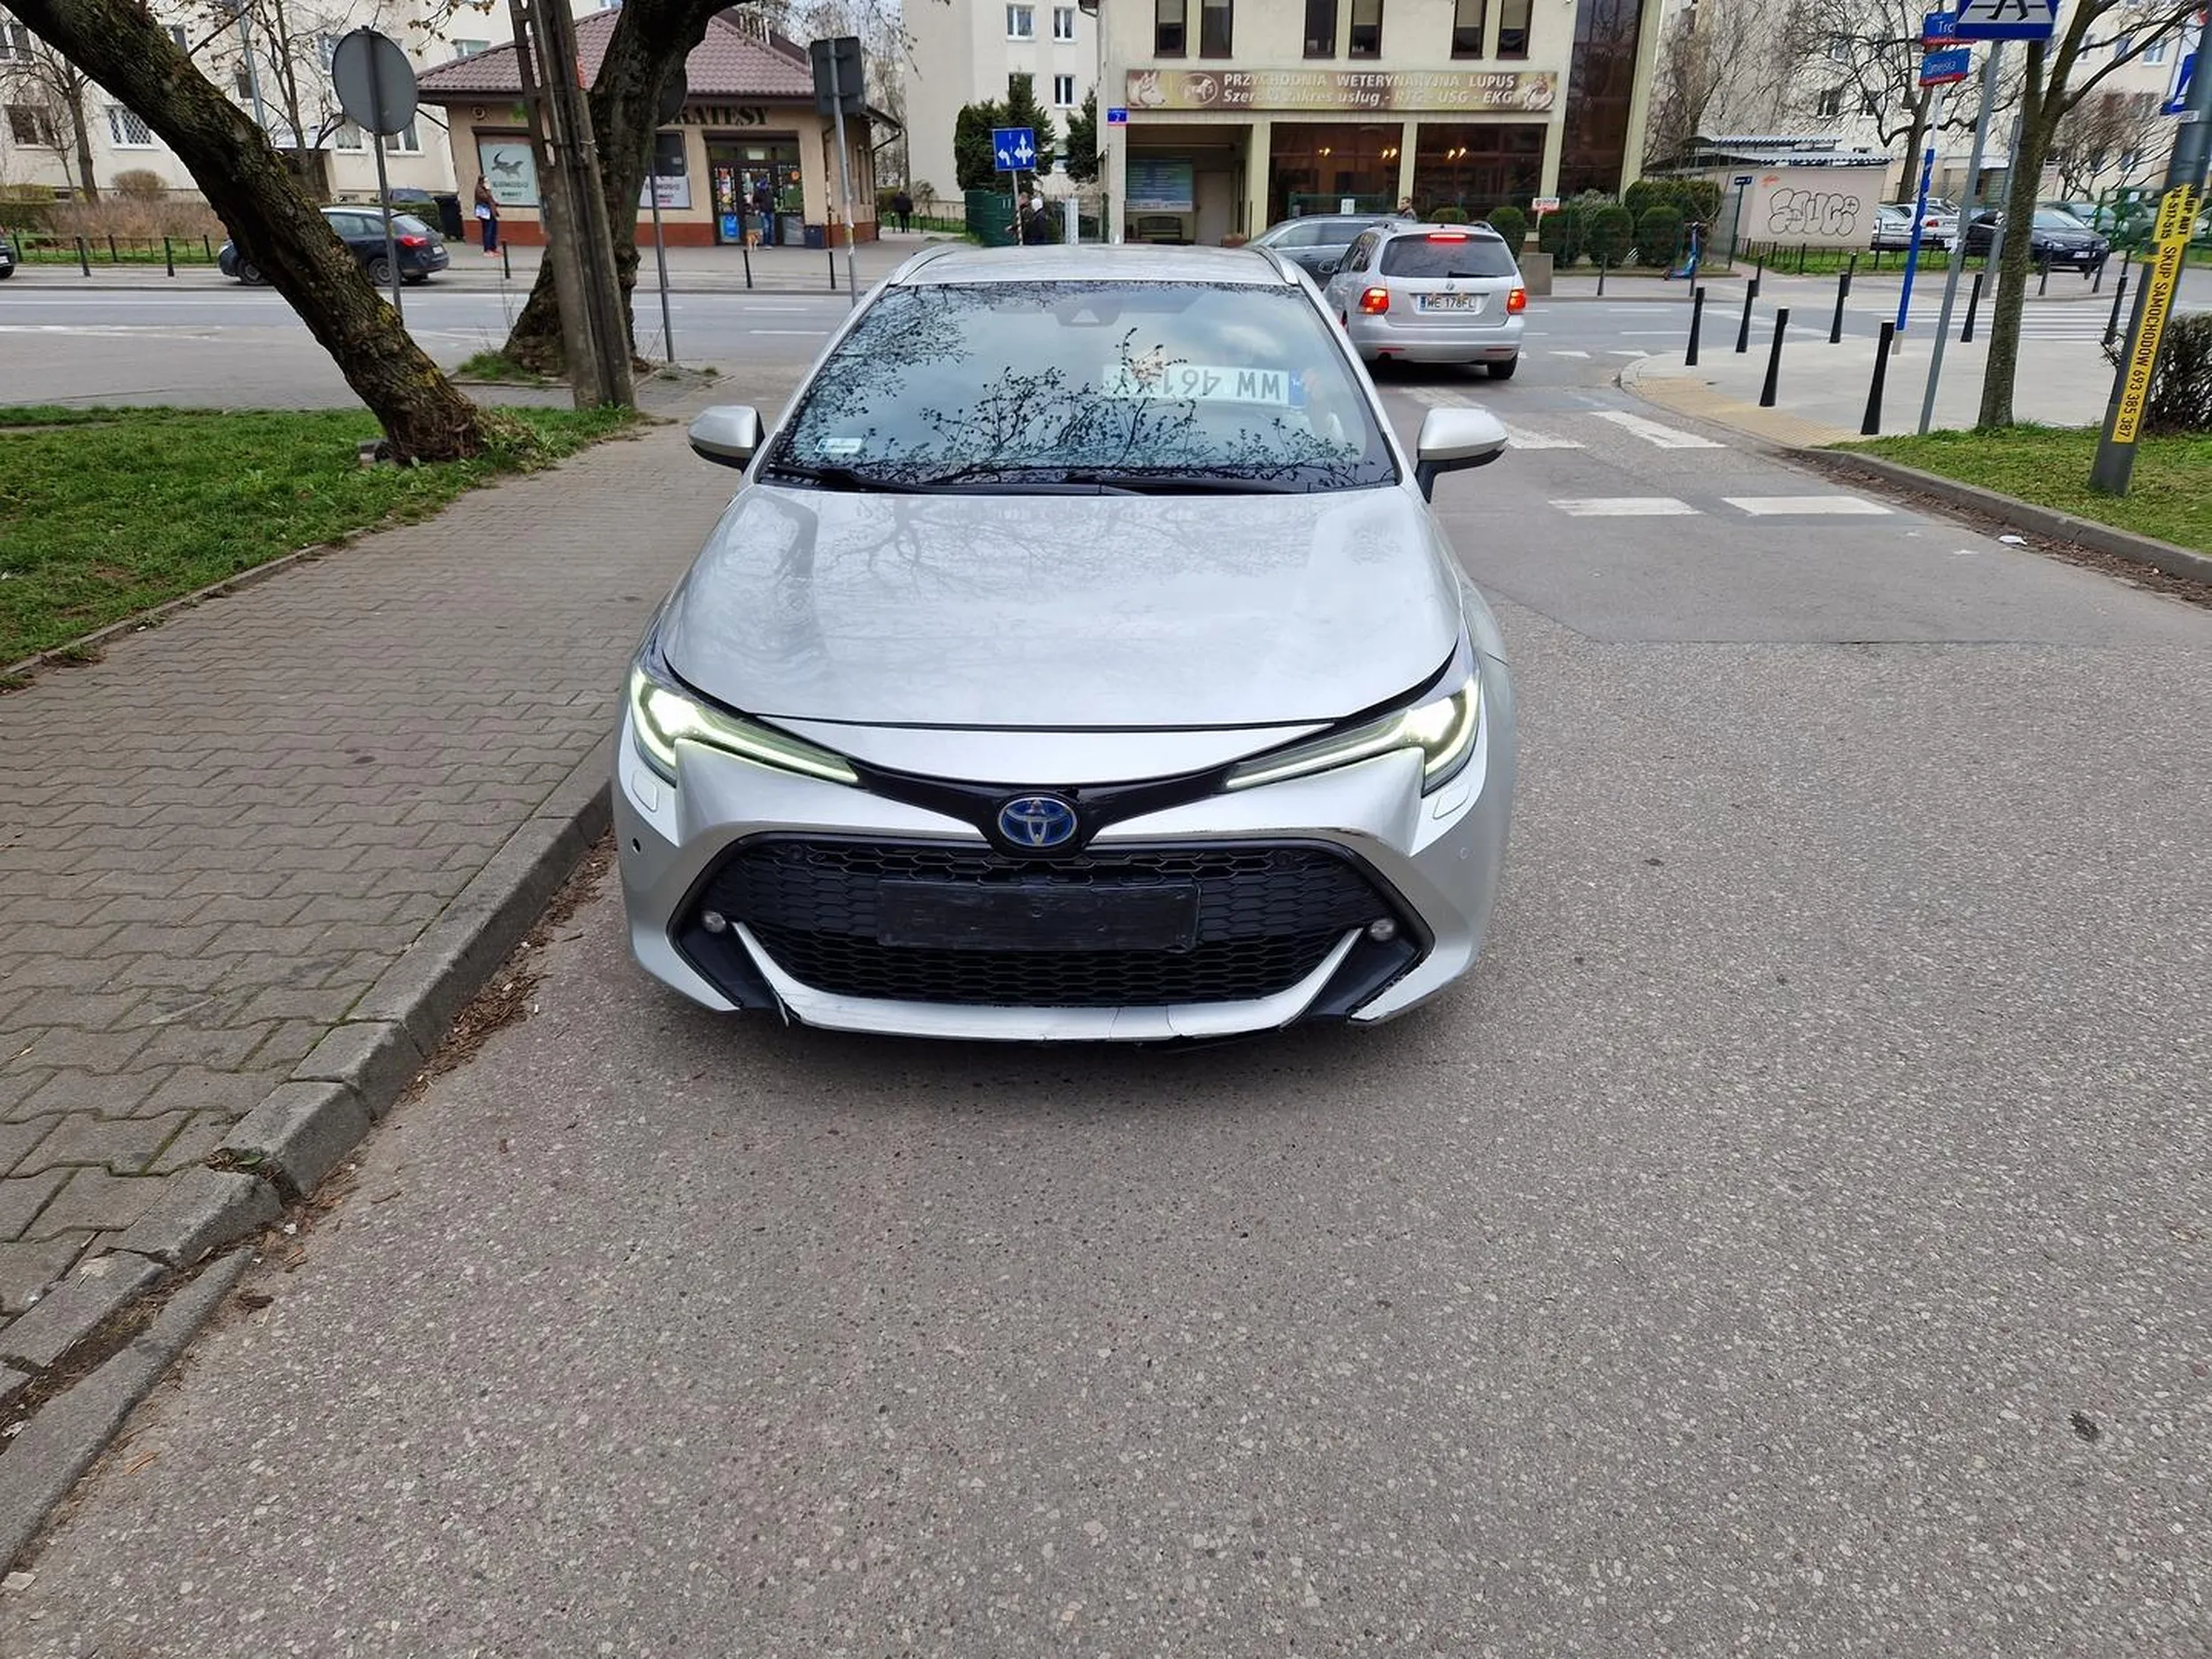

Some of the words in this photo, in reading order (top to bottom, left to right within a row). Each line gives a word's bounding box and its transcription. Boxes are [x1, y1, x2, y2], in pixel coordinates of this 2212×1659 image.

[1469, 74, 1516, 88] LUPUS
[1438, 90, 1470, 104] USG
[1482, 90, 1514, 104] EKG
[2158, 246, 2177, 279] SKUP
[1426, 296, 1441, 308] WE
[2130, 370, 2146, 391] 693
[2124, 394, 2140, 414] 385
[2119, 417, 2134, 437] 387
